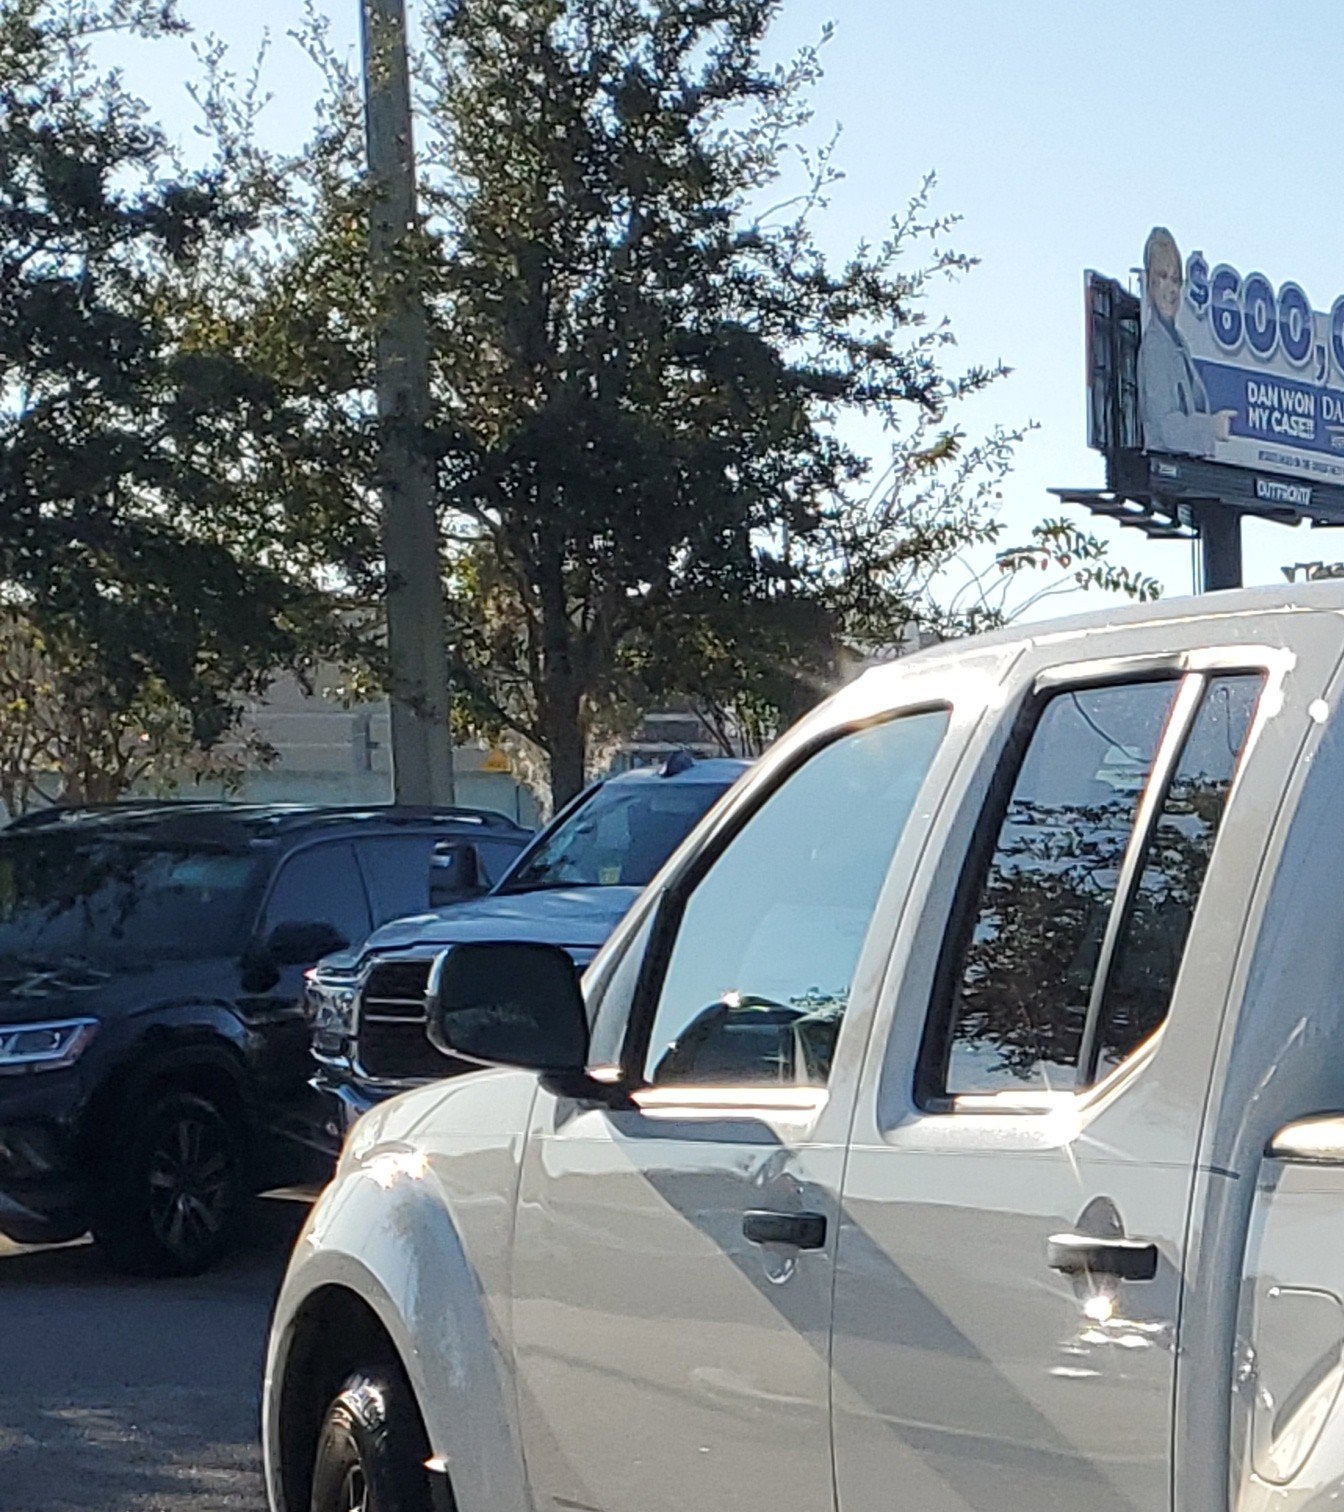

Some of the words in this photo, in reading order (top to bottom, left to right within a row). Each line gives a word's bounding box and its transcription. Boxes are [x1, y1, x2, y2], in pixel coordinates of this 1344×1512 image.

[1247, 381, 1278, 408] DAN
[1280, 388, 1314, 416] WON
[1249, 407, 1270, 430] MY
